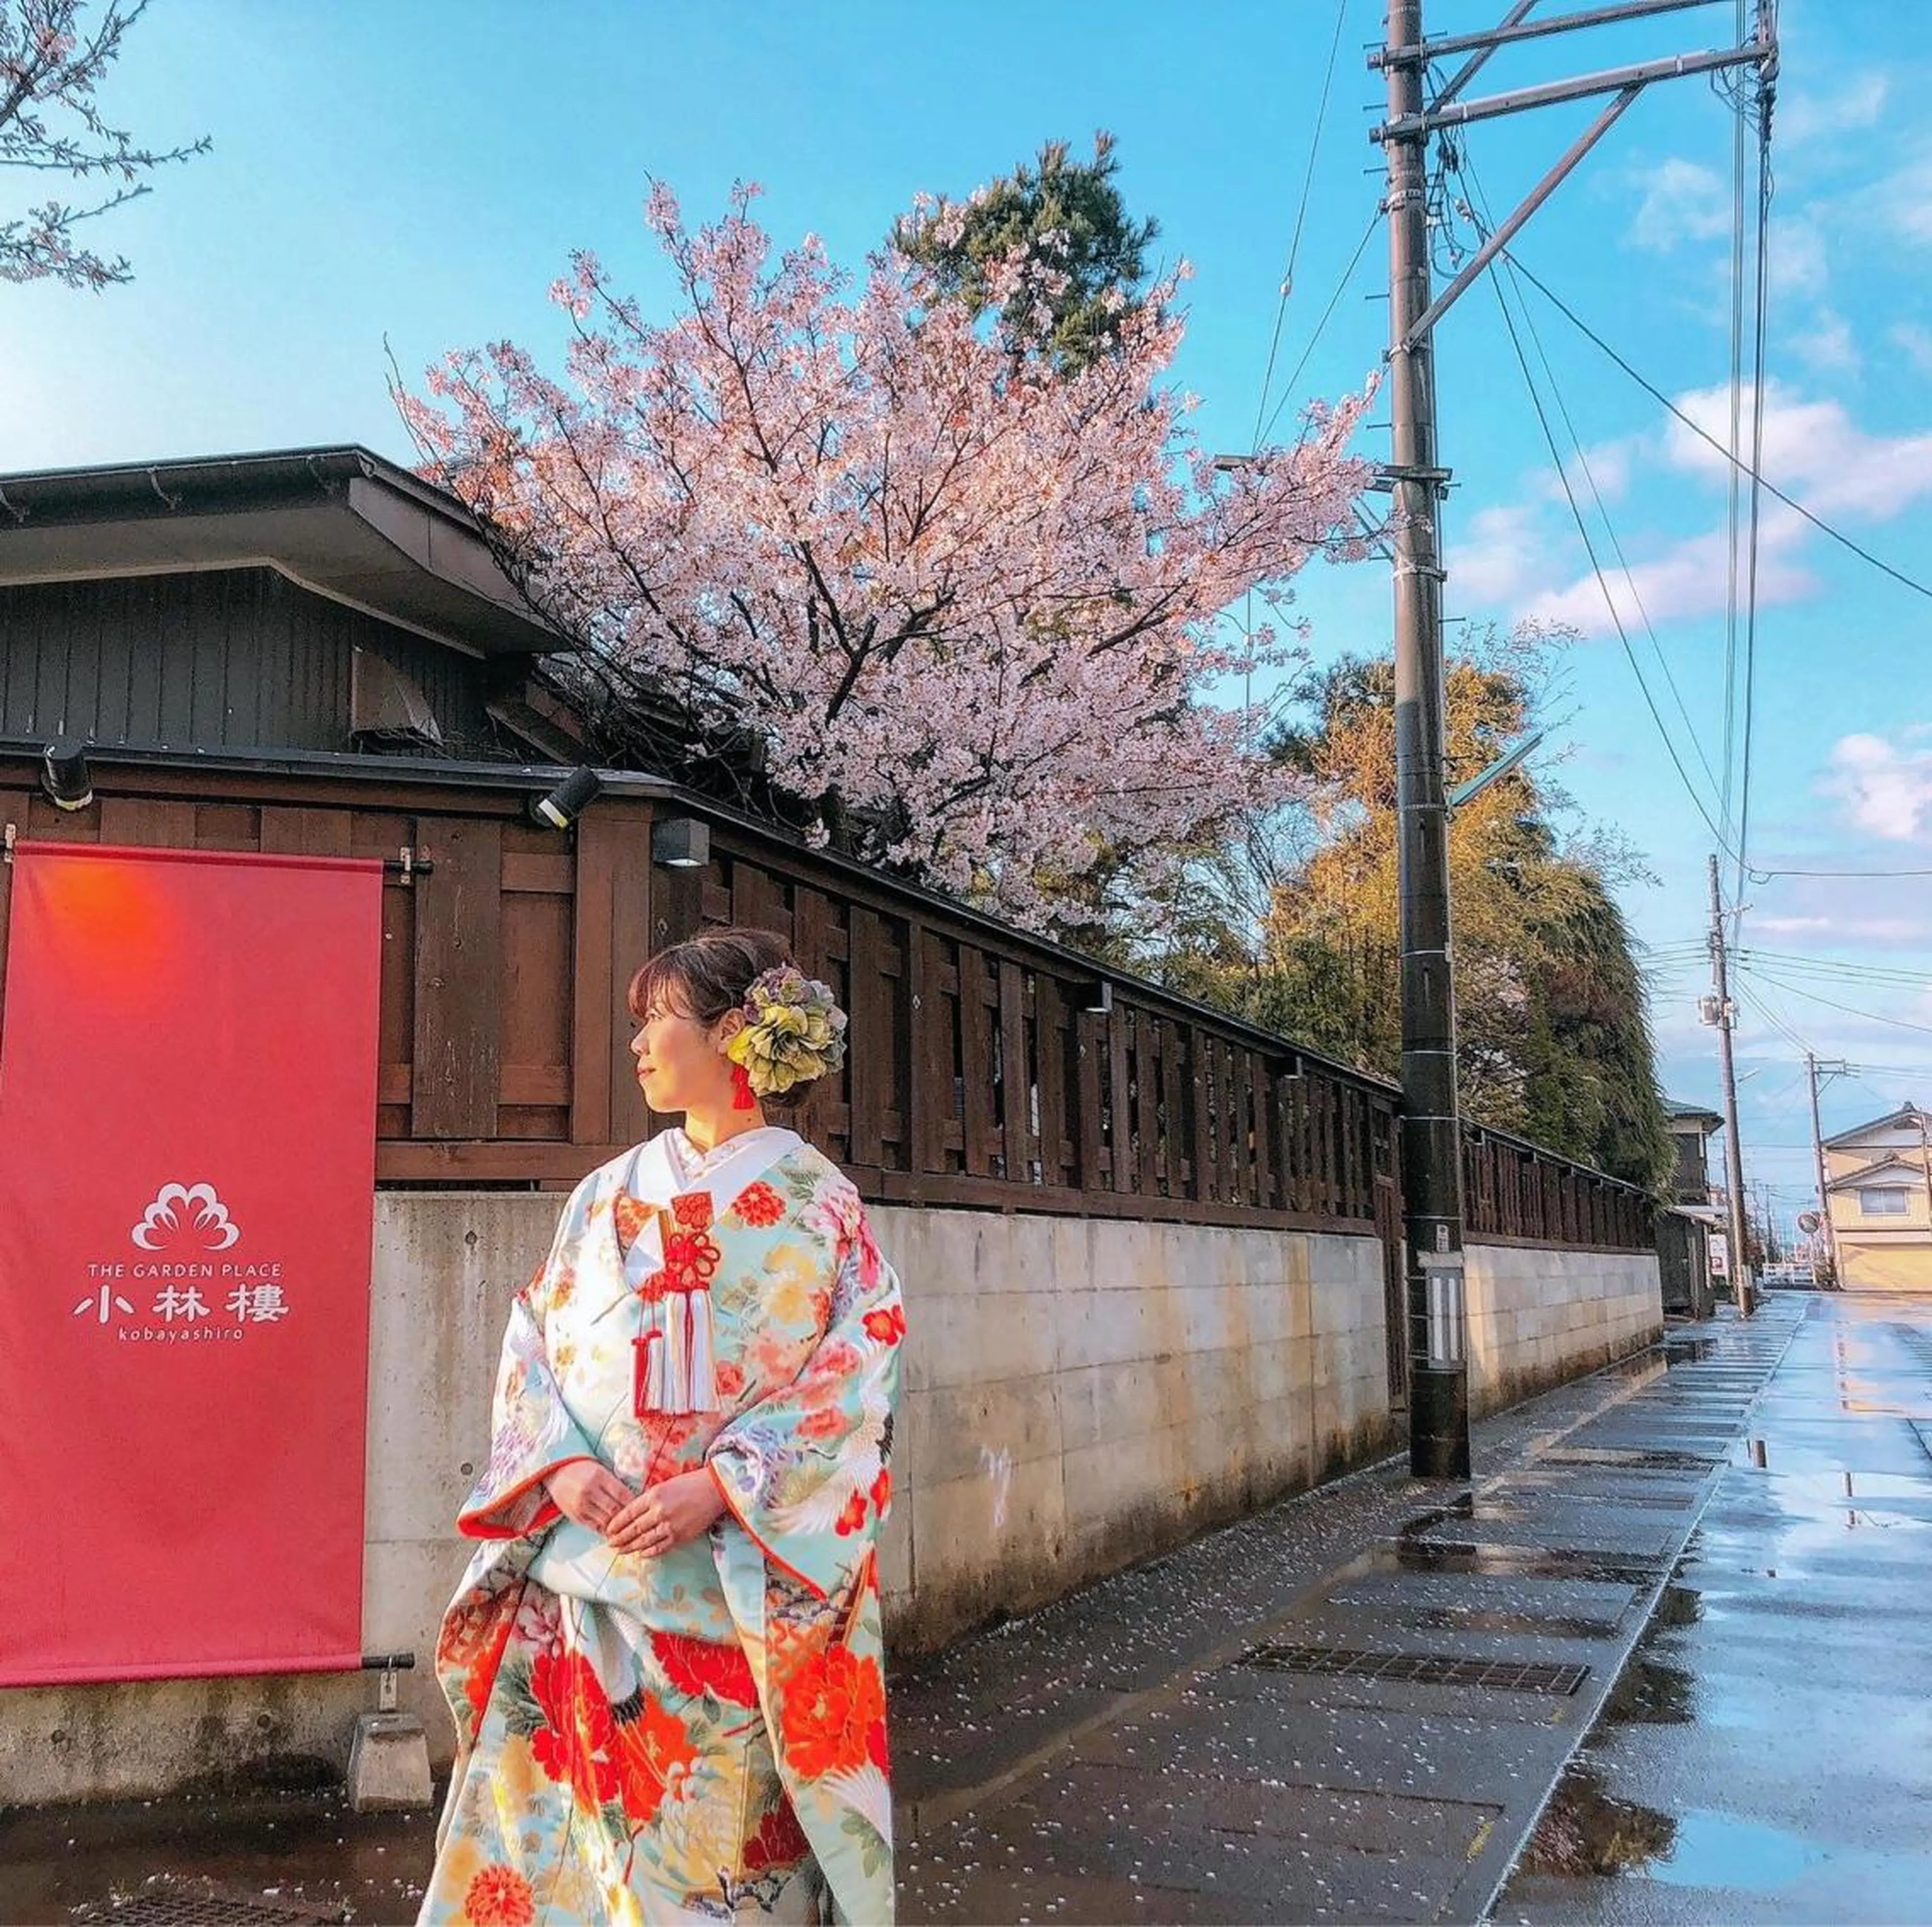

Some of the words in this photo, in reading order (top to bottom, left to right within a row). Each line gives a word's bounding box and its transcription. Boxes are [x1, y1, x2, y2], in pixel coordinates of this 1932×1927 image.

[89, 1263, 124, 1277] THE
[133, 1263, 213, 1277] GARDEN
[222, 1263, 281, 1277] PLACE
[73, 1284, 289, 1324] 小林樓
[119, 1326, 244, 1344] kobayashiro
